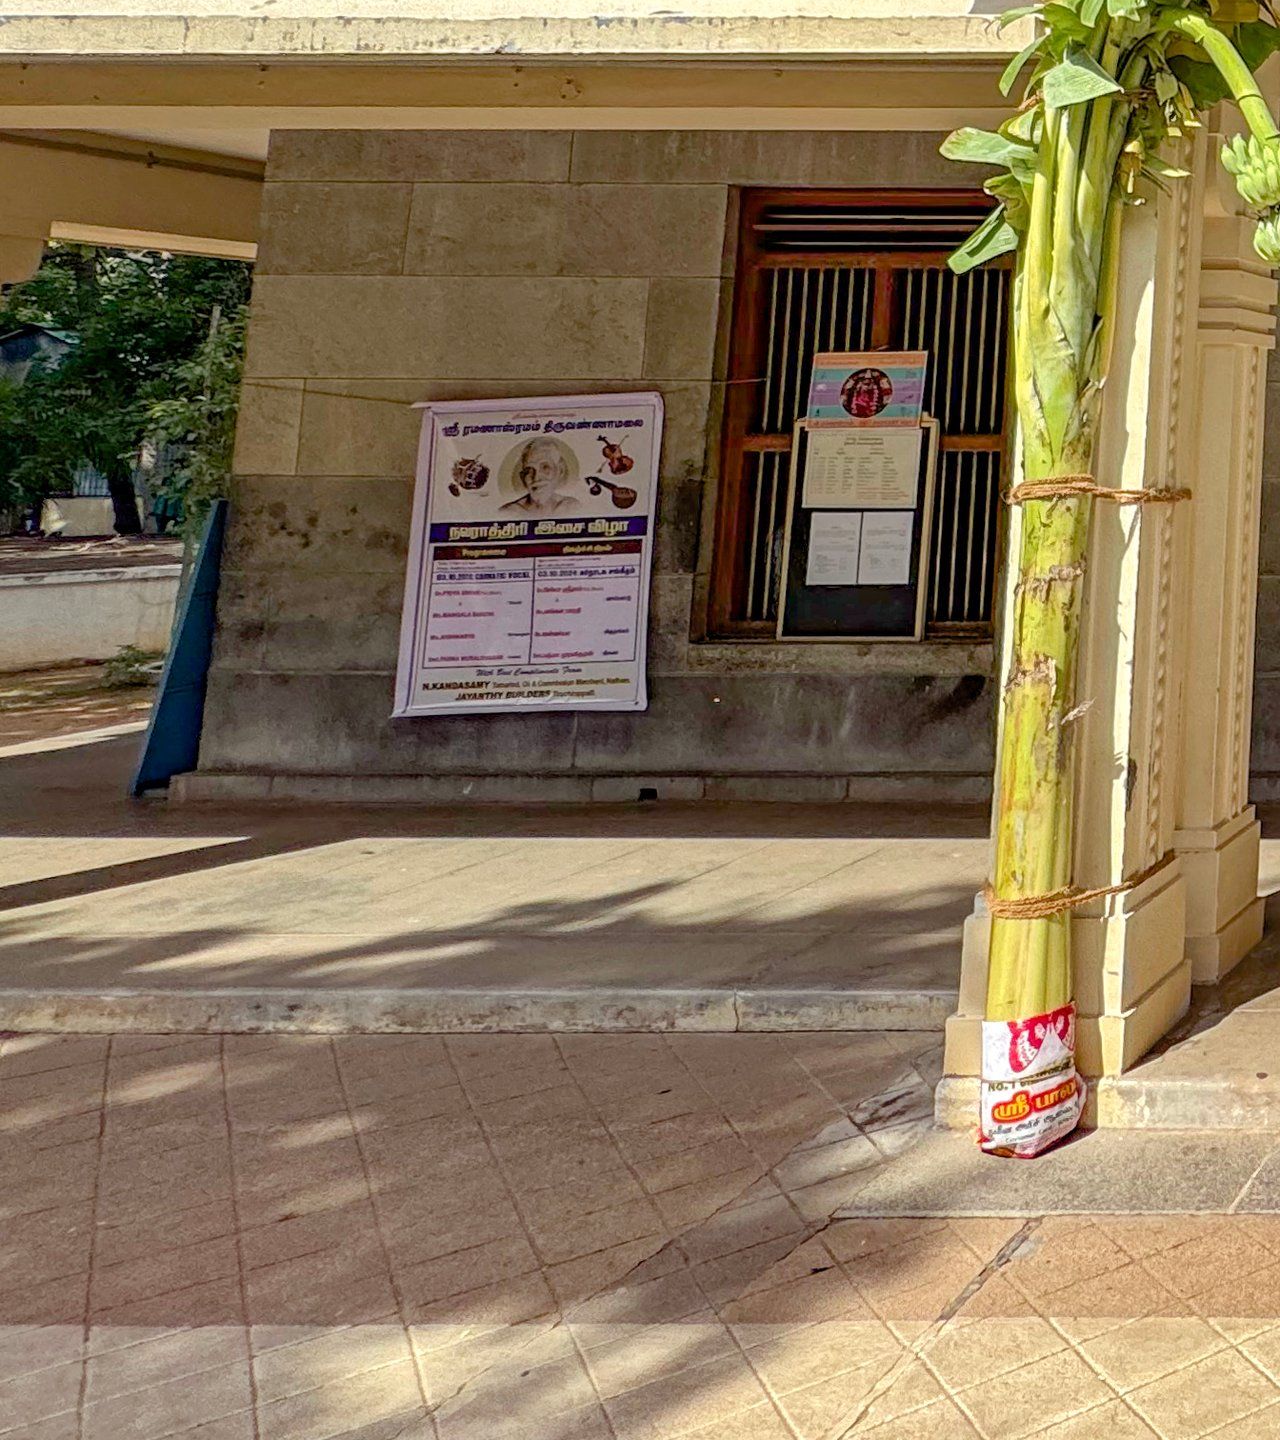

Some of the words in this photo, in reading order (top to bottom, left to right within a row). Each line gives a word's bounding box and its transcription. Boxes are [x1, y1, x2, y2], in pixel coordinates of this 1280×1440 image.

[542, 418, 644, 434] திருவண்ணாமலை
[449, 521, 528, 541] நவராத்திரி
[534, 520, 586, 536] இசை
[587, 518, 630, 537] விழா
